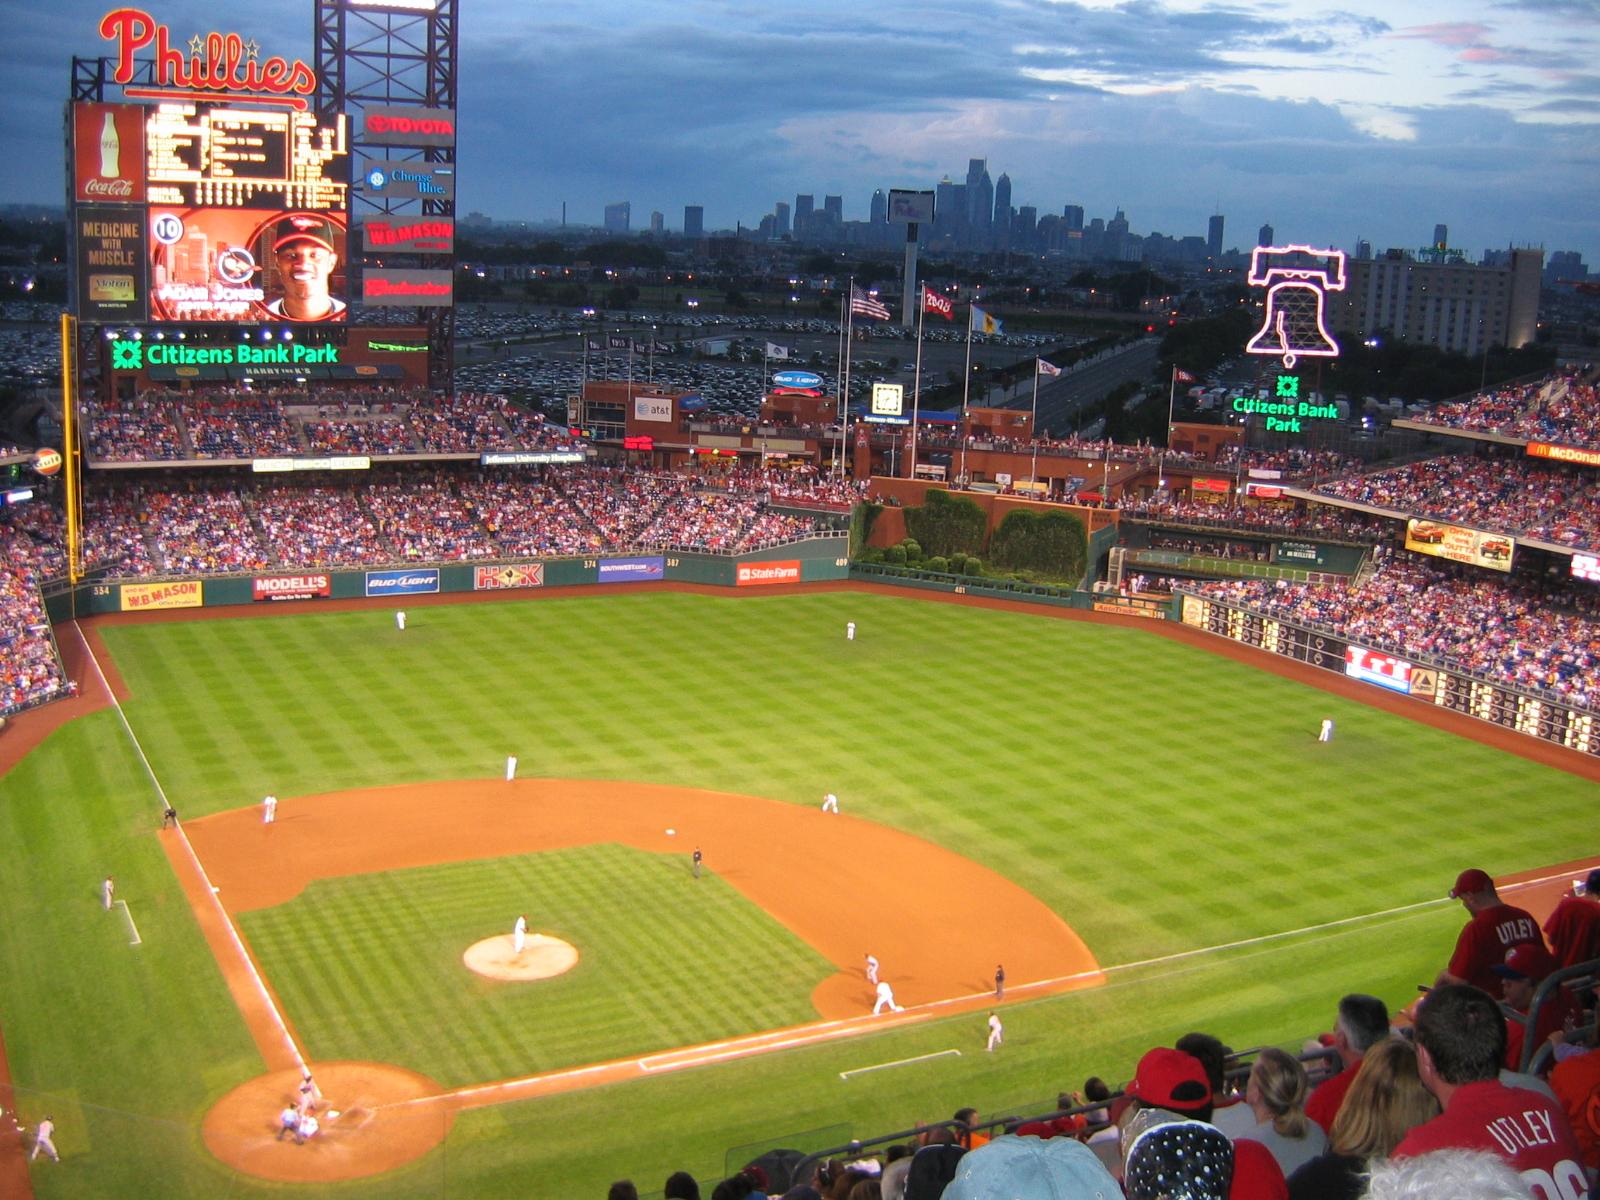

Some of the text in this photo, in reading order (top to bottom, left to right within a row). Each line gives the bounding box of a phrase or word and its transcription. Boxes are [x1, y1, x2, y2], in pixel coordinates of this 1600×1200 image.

[99, 8, 316, 95] Phillies
[389, 117, 453, 135] TOYOTA
[391, 168, 433, 182] Choose
[85, 178, 134, 196] Coca-Cola
[83, 222, 139, 238] MEDICINE
[159, 220, 179, 238] 10
[397, 222, 453, 241] MASON
[102, 238, 121, 249] WITH
[88, 250, 135, 266] MUSCLE
[926, 293, 951, 313] 2008
[147, 343, 338, 364] Citizens Bank Park
[650, 406, 670, 415] at&t
[1233, 397, 1338, 419] Citizens Bank
[1266, 416, 1301, 433] Park
[516, 454, 550, 464] University
[584, 560, 596, 568] 374
[1446, 551, 1473, 561] HERE
[256, 576, 327, 590] MODELL'S
[368, 576, 437, 587] BUD LIGHT
[151, 583, 197, 602] MASON
[1495, 919, 1535, 945] UTLEY
[1485, 1109, 1556, 1155] UTLEY
